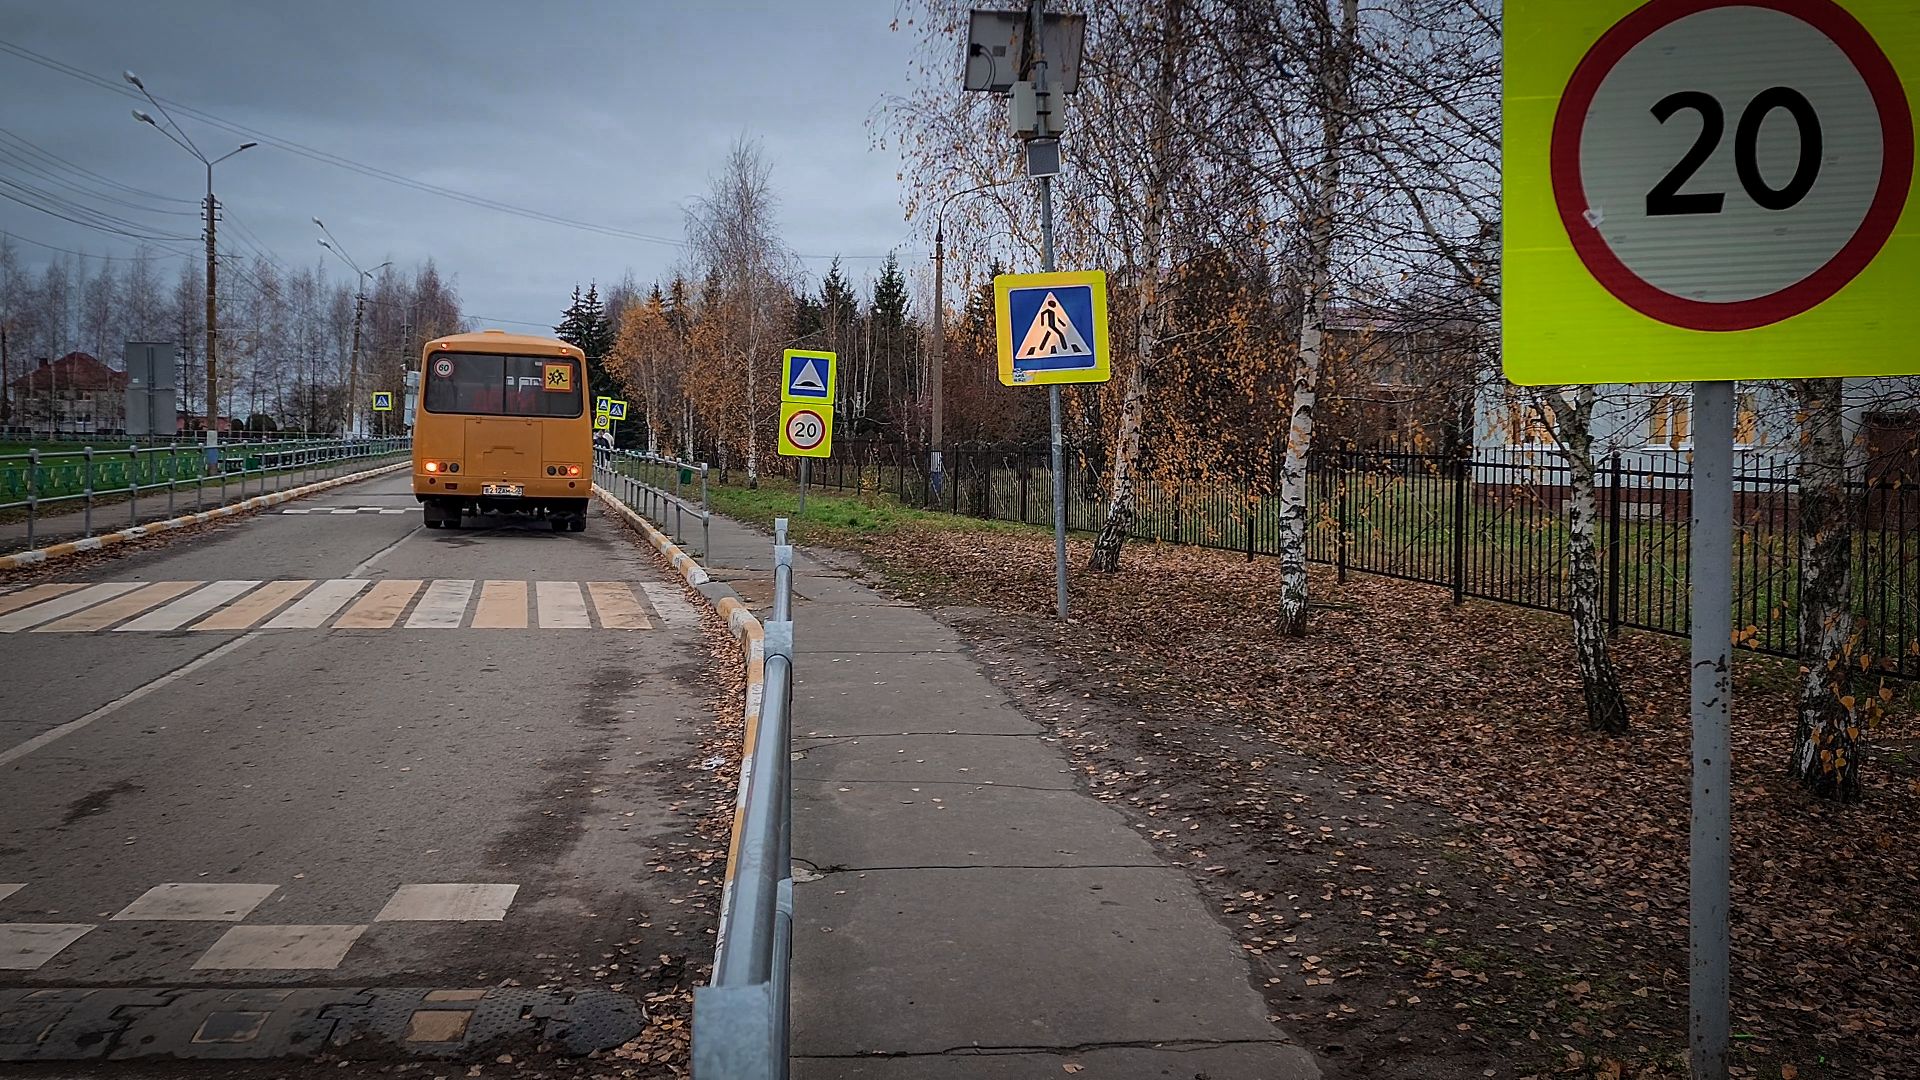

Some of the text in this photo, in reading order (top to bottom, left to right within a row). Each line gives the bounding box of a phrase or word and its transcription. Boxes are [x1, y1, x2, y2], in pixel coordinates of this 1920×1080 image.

[1646, 86, 1823, 216] 20
[438, 364, 450, 372] 60
[794, 421, 817, 438] 20
